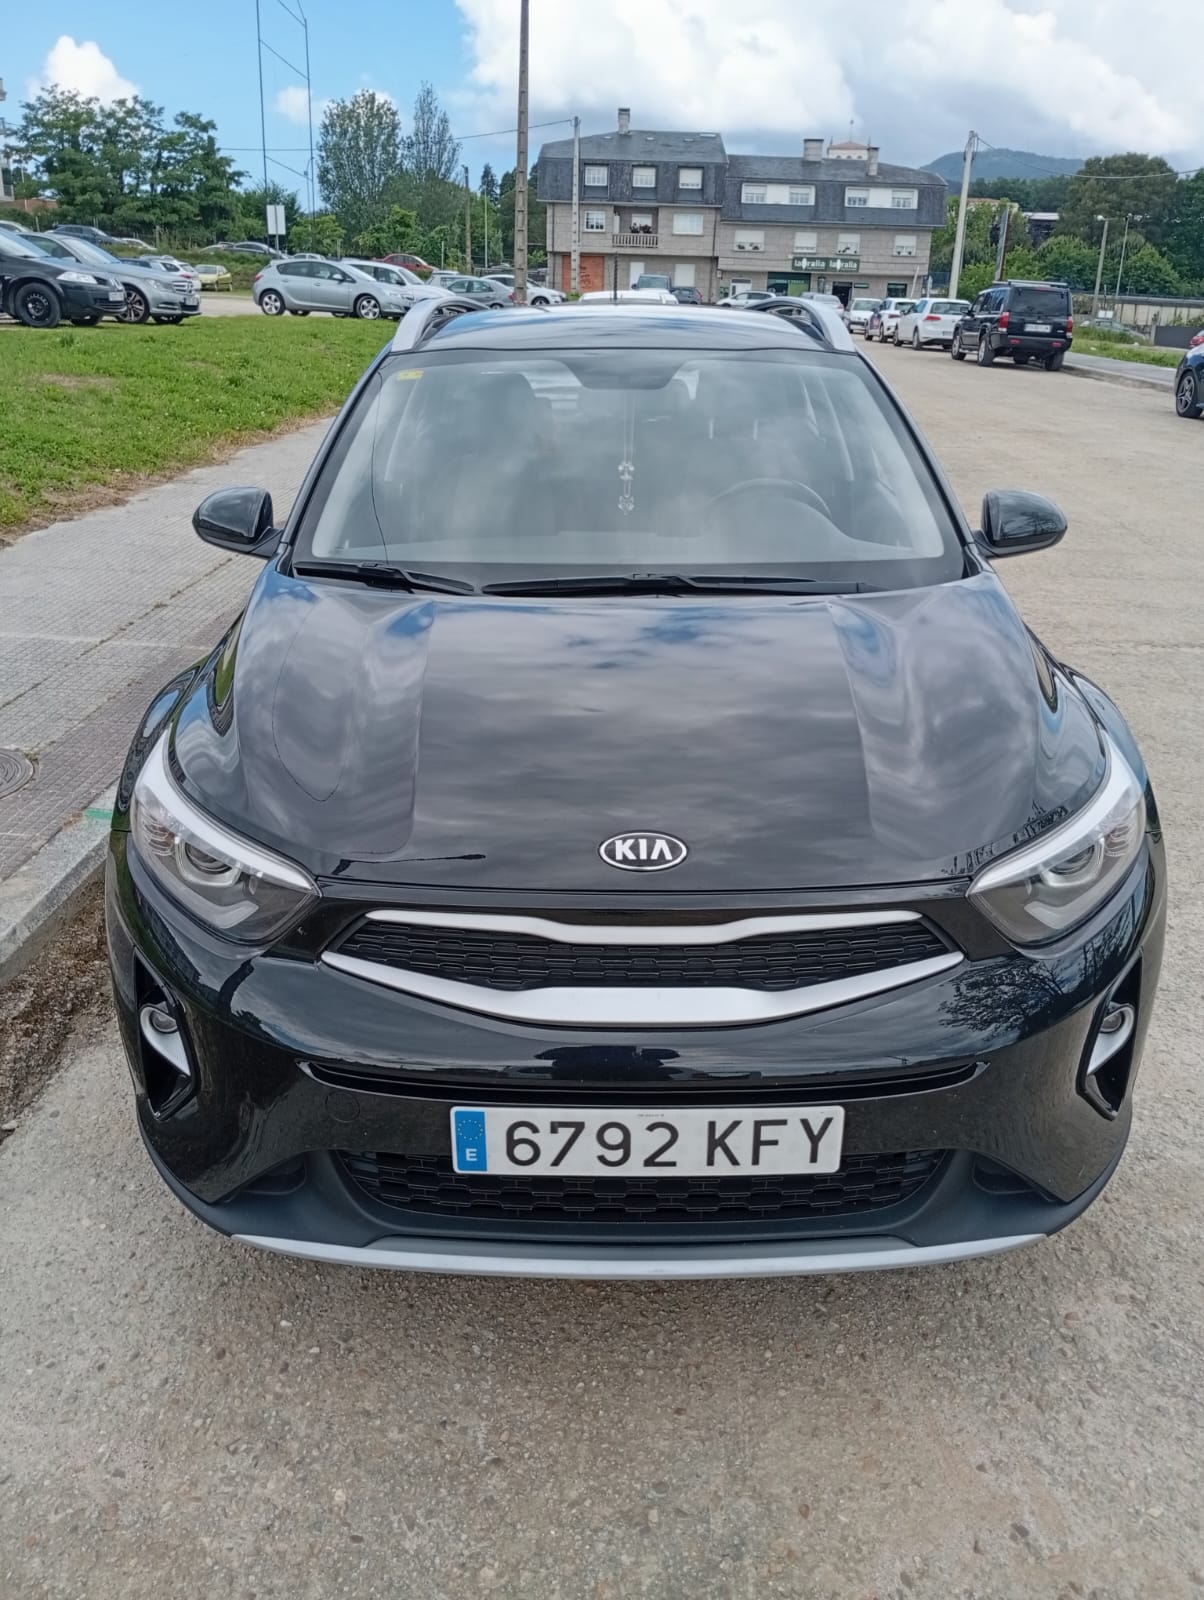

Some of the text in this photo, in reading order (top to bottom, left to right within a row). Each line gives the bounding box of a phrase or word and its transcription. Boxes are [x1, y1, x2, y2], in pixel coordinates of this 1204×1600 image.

[614, 838, 673, 861] KIA
[505, 1117, 834, 1167] 6792 KFY
[465, 1148, 478, 1162] E
